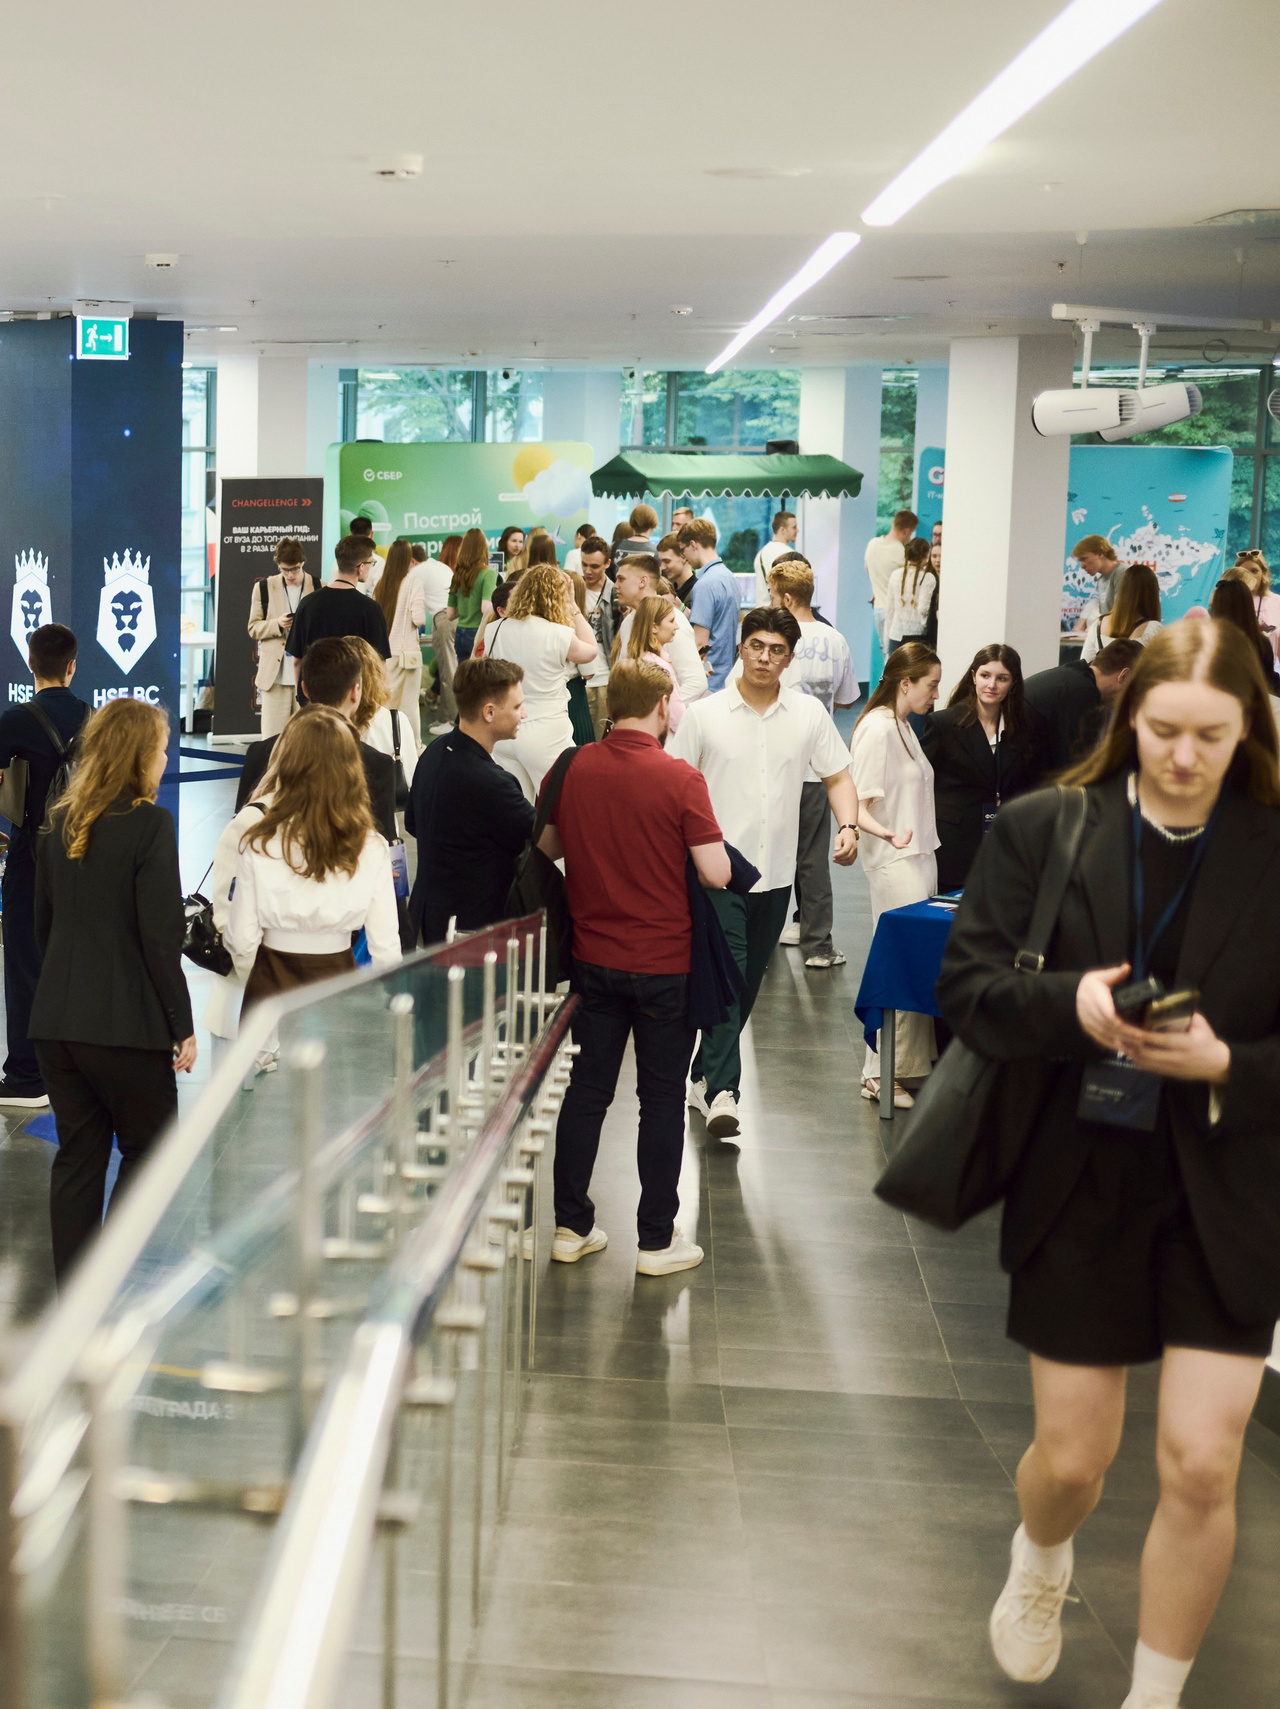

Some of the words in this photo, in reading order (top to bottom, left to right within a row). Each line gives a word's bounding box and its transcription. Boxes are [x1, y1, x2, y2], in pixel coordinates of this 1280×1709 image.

[377, 471, 402, 480] СБЕР
[232, 499, 298, 507] CHANGELLENGE
[404, 508, 482, 530] Построй
[250, 525, 293, 533] КАРЬЕРНЫЙ
[8, 682, 34, 702] HSE
[133, 685, 160, 705] BC
